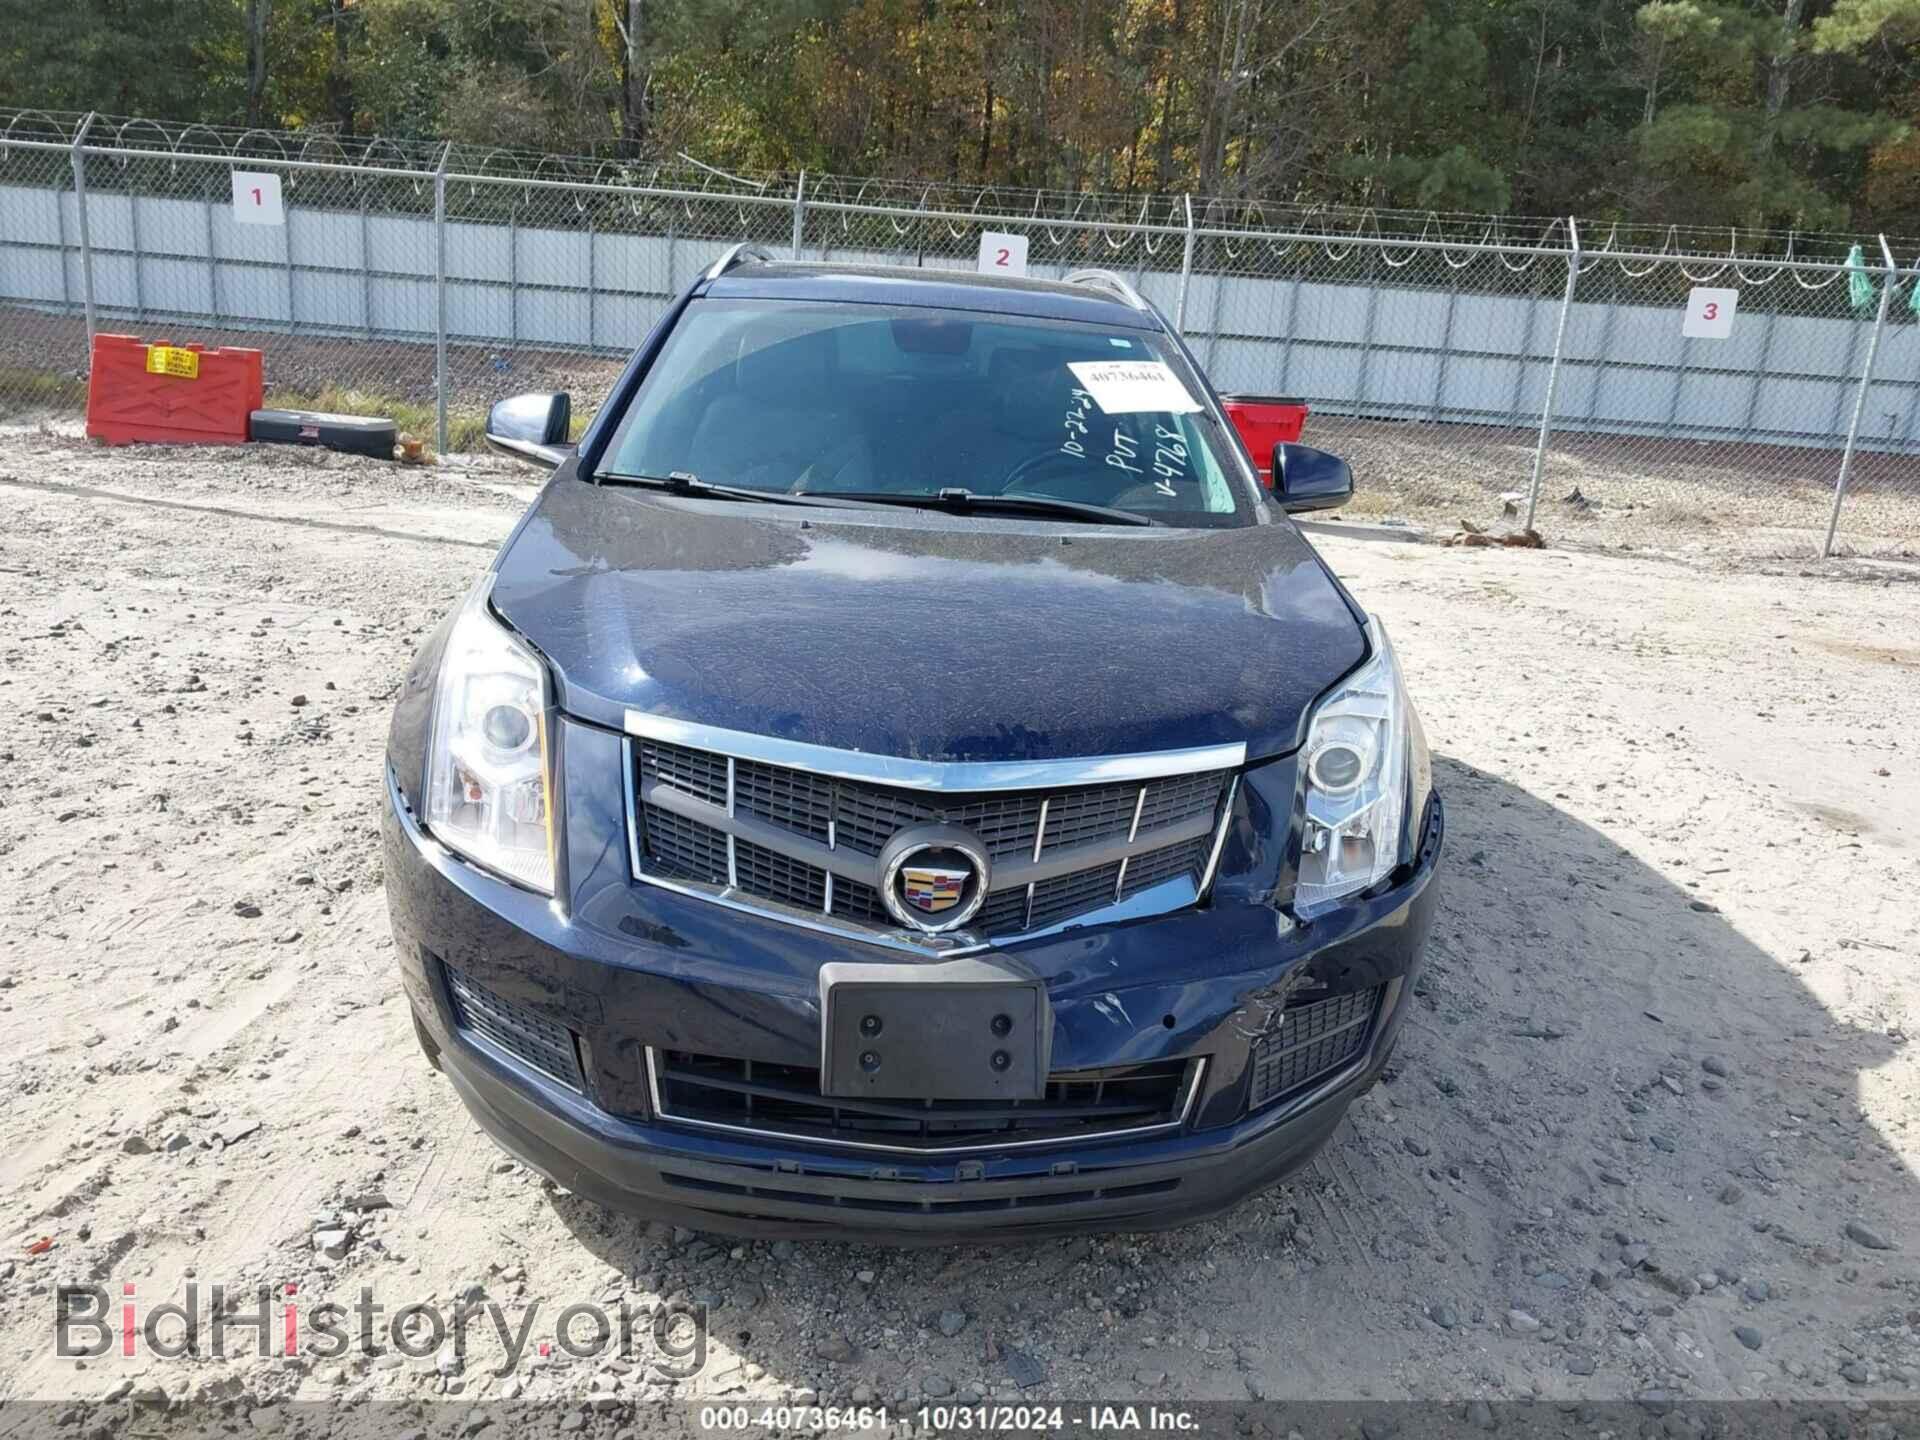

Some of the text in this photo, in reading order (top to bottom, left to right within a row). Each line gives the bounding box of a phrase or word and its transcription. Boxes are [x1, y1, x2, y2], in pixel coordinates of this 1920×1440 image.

[251, 188, 262, 206] 1
[995, 248, 1010, 267] 2
[1703, 302, 1719, 321] 3
